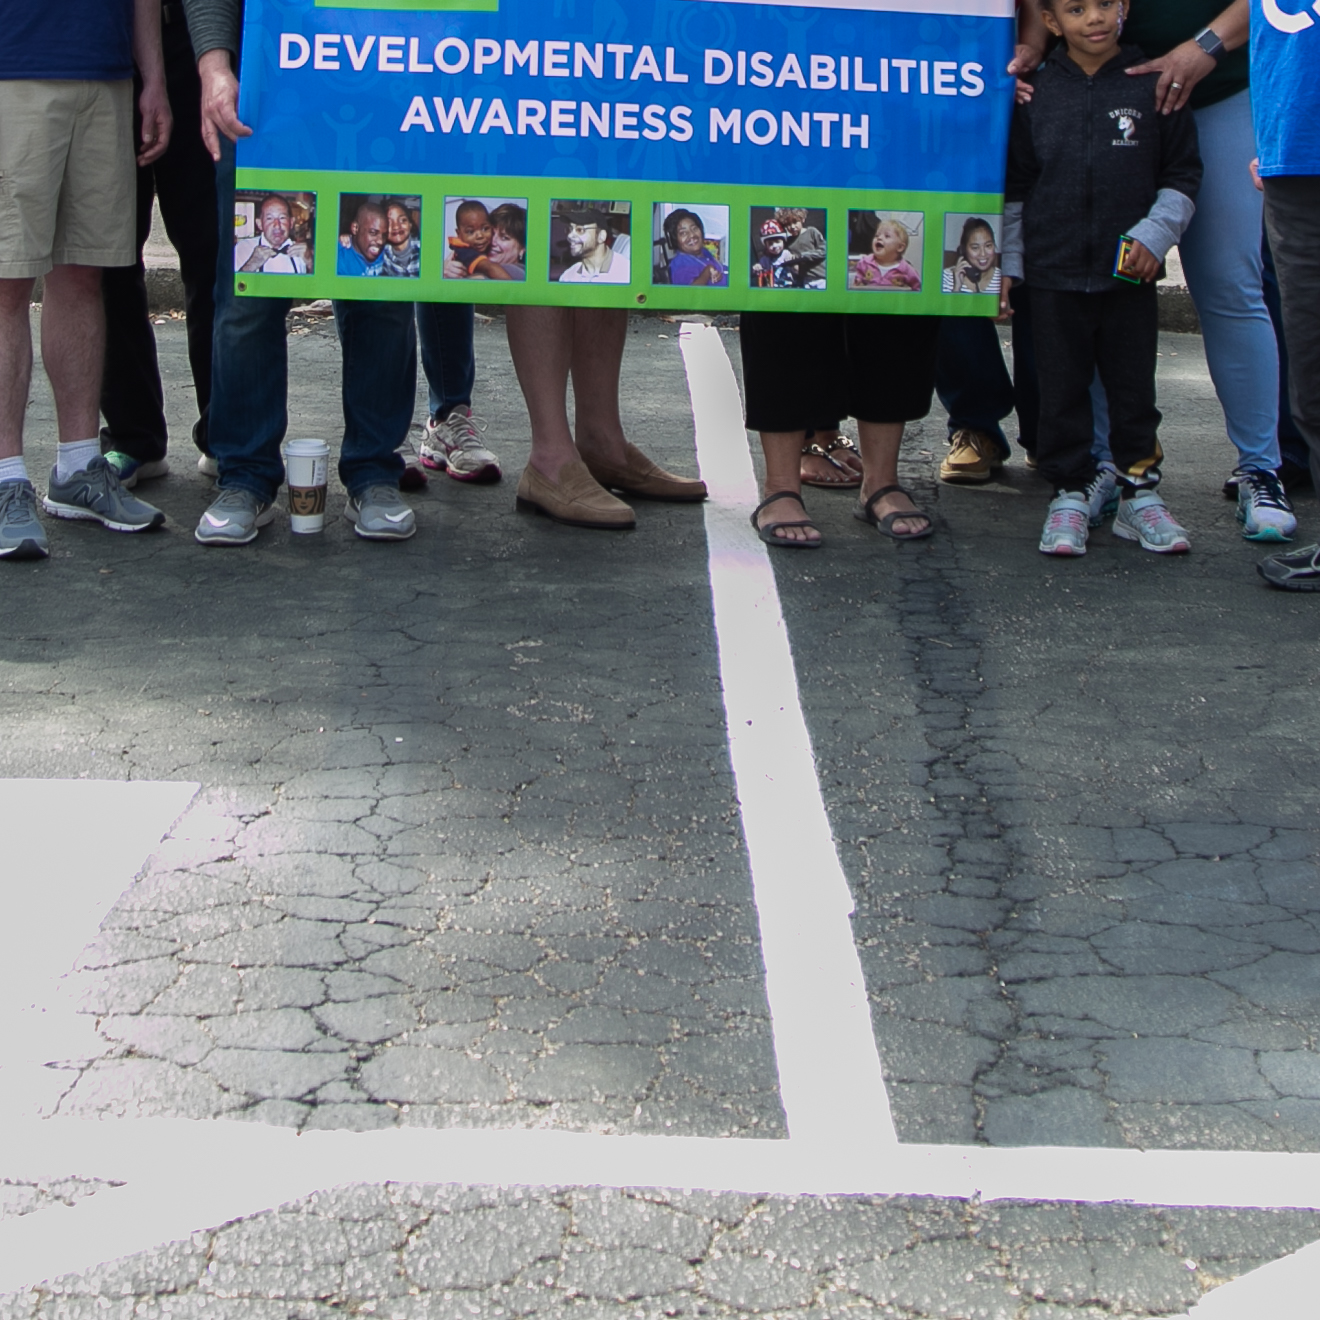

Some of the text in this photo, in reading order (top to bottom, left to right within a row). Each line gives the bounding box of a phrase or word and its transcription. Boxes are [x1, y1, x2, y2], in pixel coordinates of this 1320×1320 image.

[280, 33, 985, 97] DEVELOPMENTAL DISABILITIES
[400, 95, 869, 149] AWARENESS MONTH
[1108, 108, 1142, 119] UNICORN
